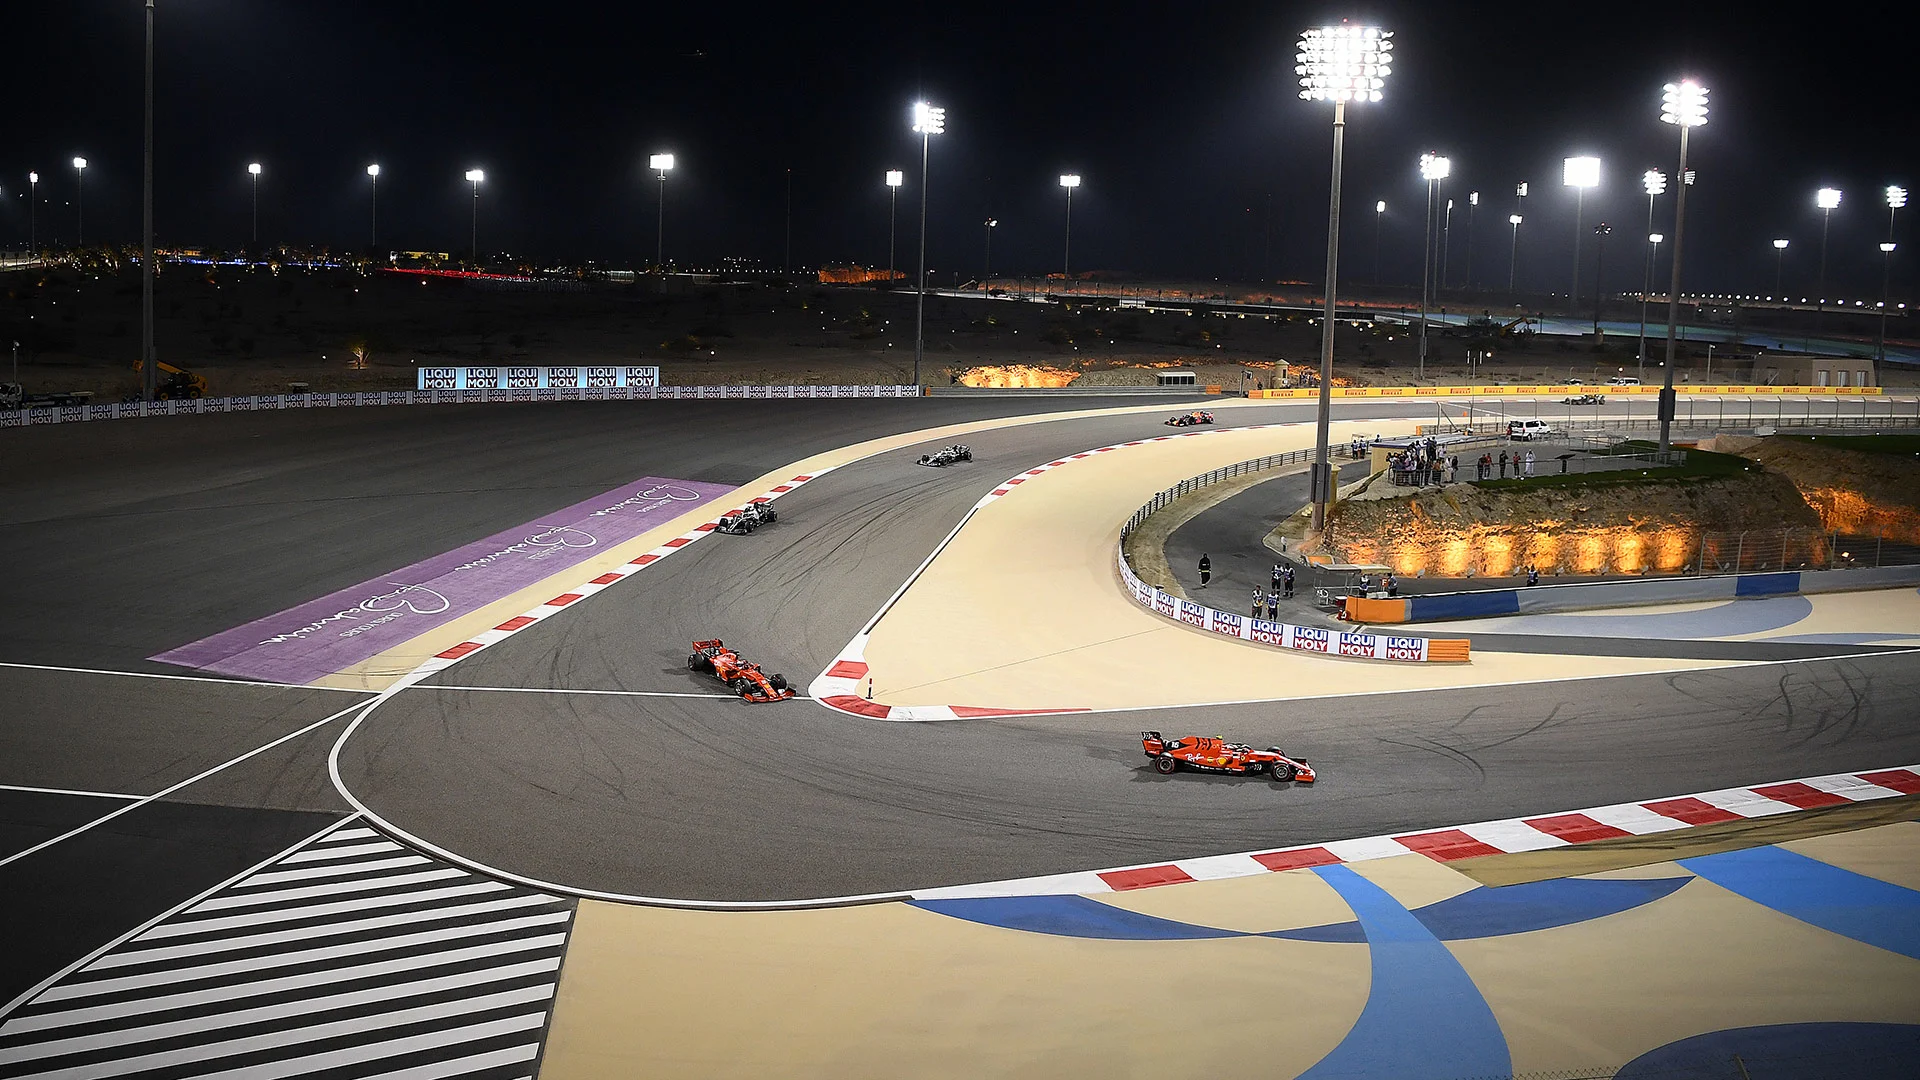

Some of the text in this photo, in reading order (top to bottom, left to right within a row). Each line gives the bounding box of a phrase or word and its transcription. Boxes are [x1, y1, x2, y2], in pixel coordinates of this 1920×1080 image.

[426, 369, 454, 378] LIQUI
[468, 369, 496, 378] LIQUI
[509, 369, 536, 378] LIQUI
[549, 368, 576, 377] LIQUI
[589, 368, 615, 377] LIQUI
[627, 368, 653, 377] LIQUI
[426, 379, 455, 388] MOLY
[468, 379, 497, 388] MOLY
[509, 378, 537, 387] MOLY
[549, 378, 577, 387] MOLY
[589, 378, 616, 386] MOLY
[627, 378, 653, 386] MOLY
[1157, 591, 1174, 606] LIQUI
[1157, 602, 1174, 616] MOLY
[1182, 601, 1204, 617] LIQUI
[1181, 612, 1204, 627] MOLY
[1215, 611, 1240, 626] LIQUI
[1214, 622, 1240, 636] MOLY
[1253, 620, 1282, 634] LIQUI
[1252, 630, 1282, 644] MOLY
[1296, 628, 1327, 641] LIQUI
[1342, 633, 1374, 646] LIQUI
[1294, 638, 1327, 651] MOLY
[1389, 639, 1421, 649] LIQUI
[1340, 644, 1374, 656] MOLY
[1388, 649, 1421, 659] MOLY
